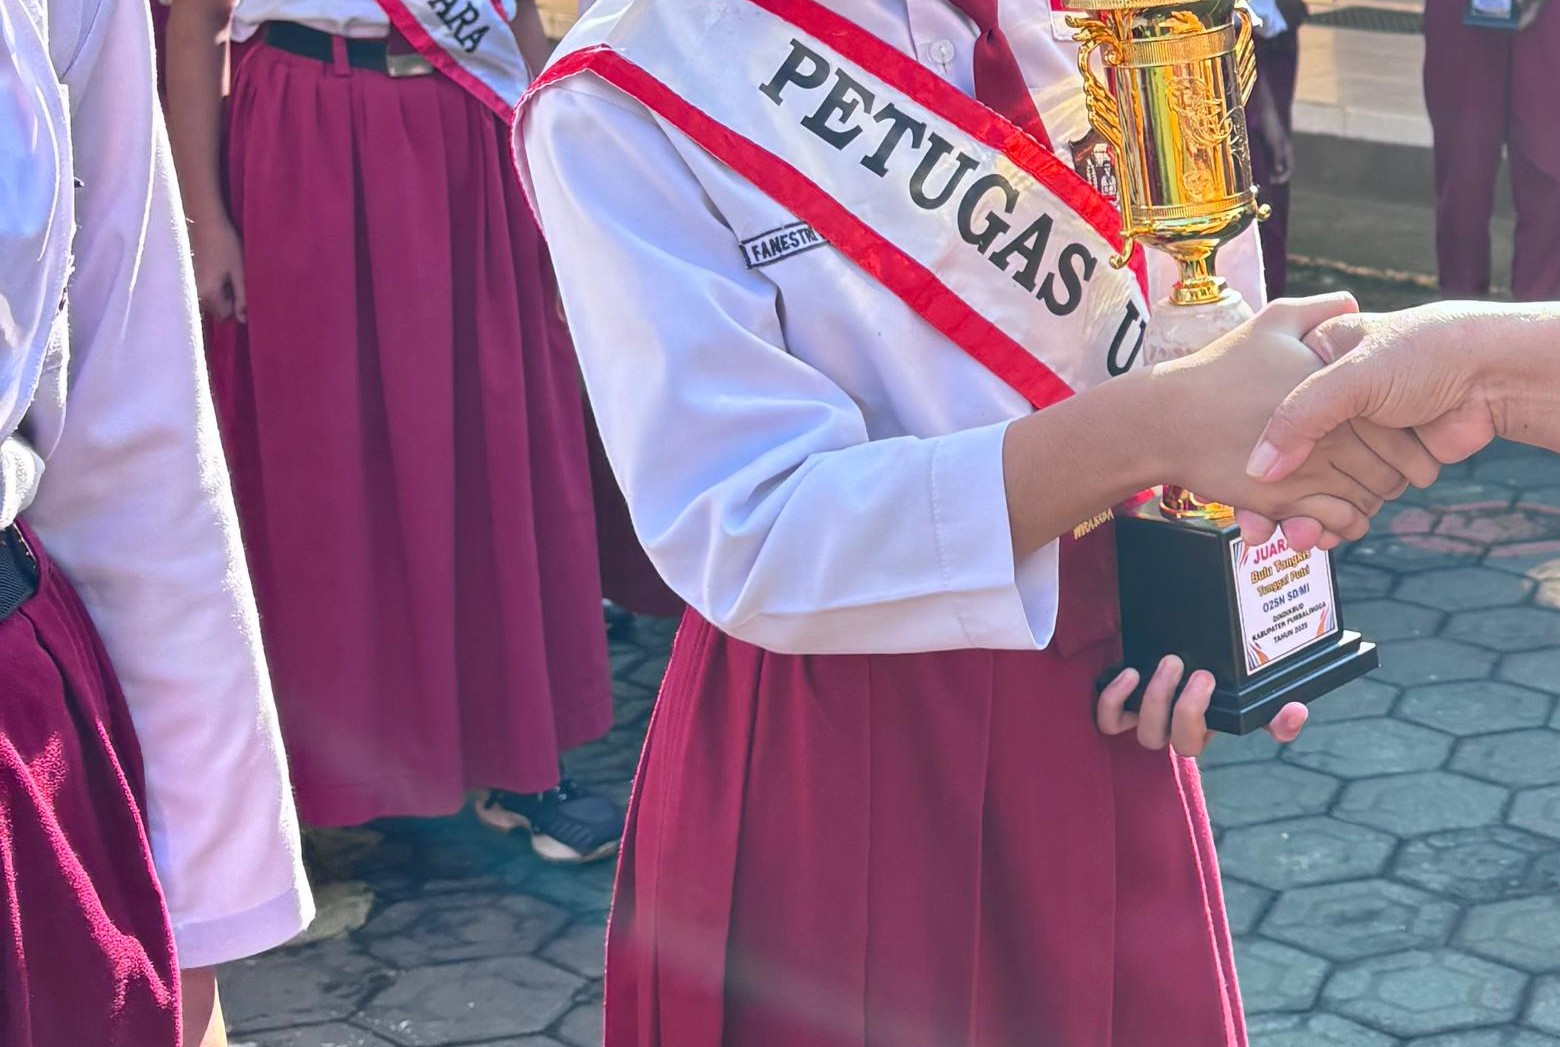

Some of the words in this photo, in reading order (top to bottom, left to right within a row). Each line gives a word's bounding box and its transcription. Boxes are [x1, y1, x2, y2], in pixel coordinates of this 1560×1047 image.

[758, 38, 1098, 316] PETUGAS
[1253, 538, 1288, 564] JUAR
[1251, 621, 1286, 642] KABUPATEN
[1286, 601, 1327, 625] PURBALINGGA
[1273, 628, 1294, 644] TAHUN
